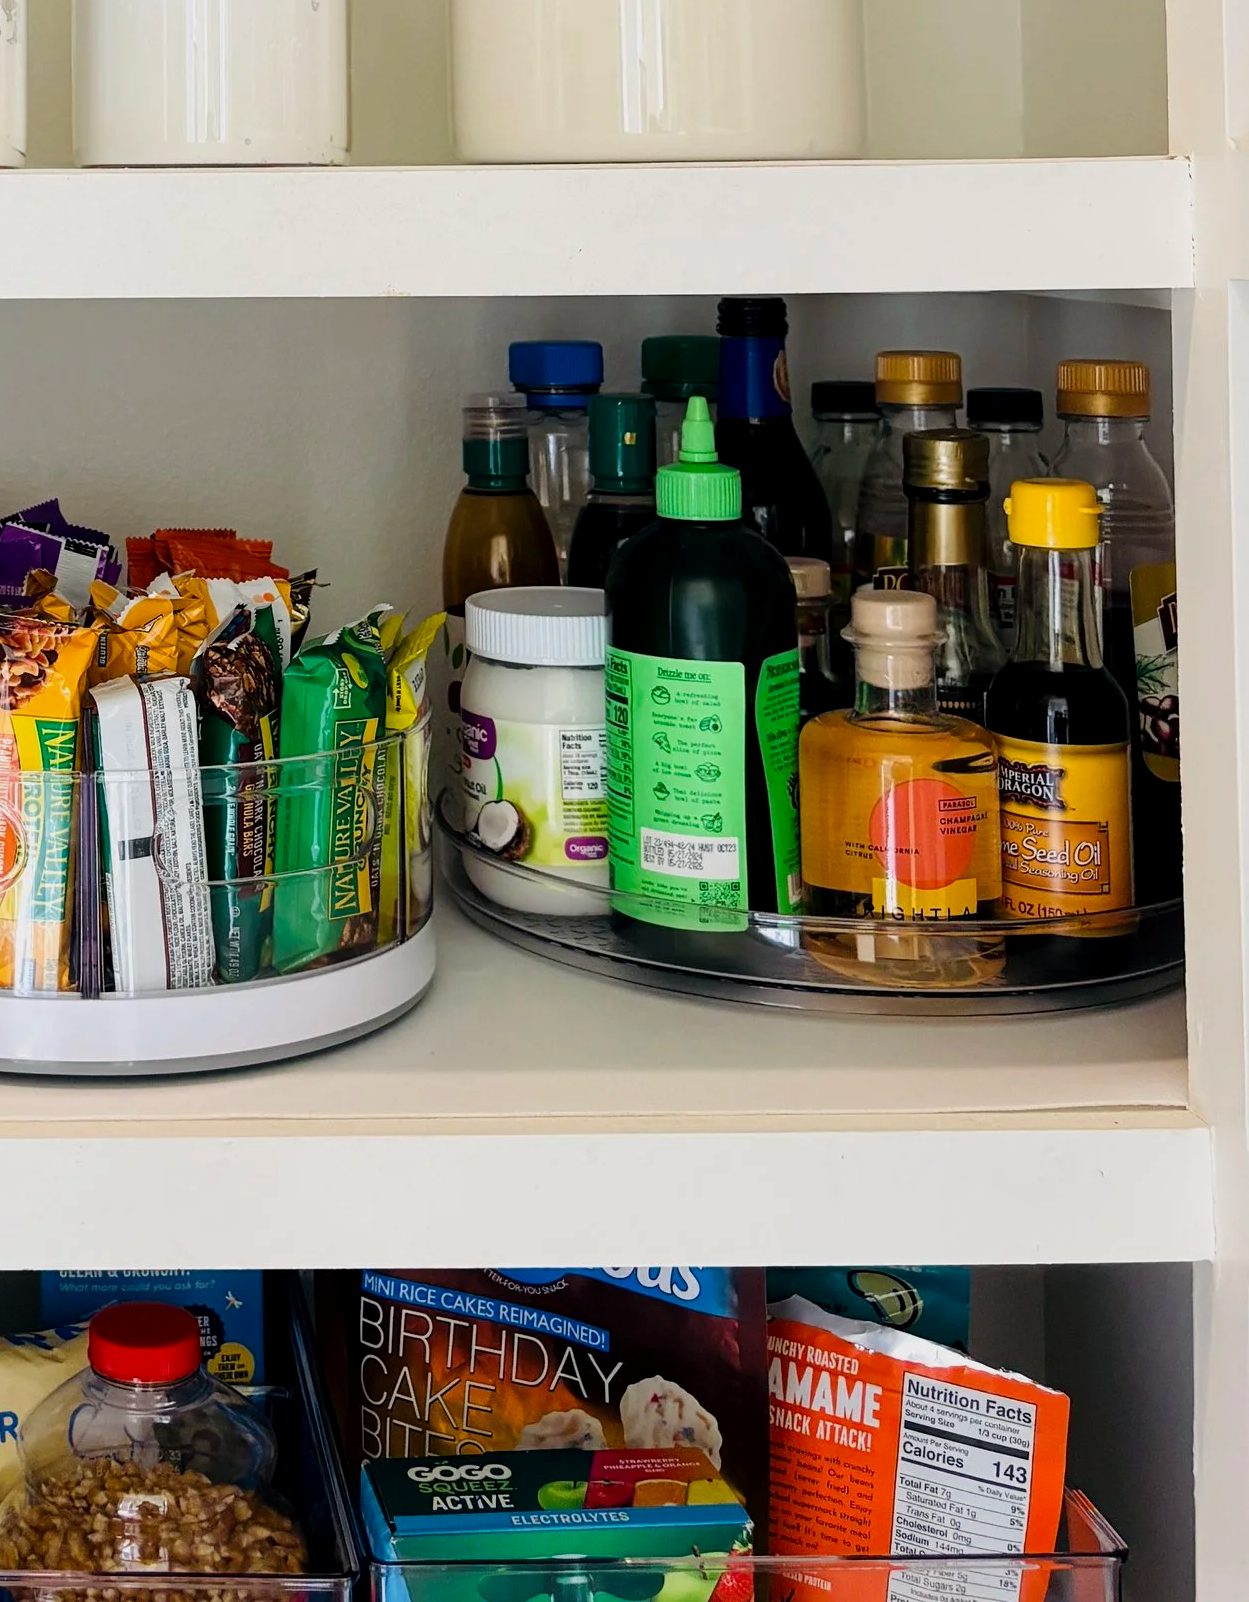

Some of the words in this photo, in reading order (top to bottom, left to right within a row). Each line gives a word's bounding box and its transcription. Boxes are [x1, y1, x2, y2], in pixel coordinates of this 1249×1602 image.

[610, 658, 628, 674] Facts
[658, 667, 683, 679] Drizzle
[614, 705, 628, 725] 120
[562, 734, 592, 742] Nutrition
[562, 742, 582, 750] Facts
[41, 726, 75, 821] NATURE
[475, 782, 487, 795] Oil
[943, 800, 974, 809] PARASOL
[940, 811, 988, 825] CHAMPAGNE
[940, 825, 978, 835] VINEGAR
[1025, 823, 1049, 837] Pure
[242, 830, 253, 857] BARS
[569, 843, 604, 855] Organic
[845, 841, 865, 849] WITH
[1021, 836, 1070, 866] Seed
[1074, 840, 1101, 866] Oil
[846, 849, 873, 860] CITRUS
[34, 824, 70, 916] VALLEY
[1020, 862, 1080, 884] Seasoning
[1081, 867, 1098, 881] Oil
[1005, 897, 1015, 911] FL
[1018, 903, 1034, 916] OZ
[60, 1282, 89, 1293] What
[121, 1282, 150, 1291] could
[153, 1283, 171, 1293] you
[174, 1281, 191, 1290] ask
[194, 1280, 216, 1290] for?
[364, 1274, 395, 1295] MINI
[399, 1283, 436, 1306] RICE
[441, 1292, 495, 1318] CAKES
[499, 1304, 606, 1348] REIMAGINED!
[221, 1354, 241, 1362] ENJOY
[361, 1296, 623, 1403] BIRTHDAY
[807, 1346, 859, 1375] ROASTED
[361, 1354, 496, 1436] CAKE
[907, 1379, 980, 1411] Nutrition
[986, 1399, 1032, 1424] Facts
[905, 1399, 928, 1411] About
[936, 1408, 968, 1422] servings
[984, 1419, 1020, 1435] container
[769, 1405, 811, 1436] SNACK
[816, 1419, 872, 1452] ATTACK!
[904, 1409, 935, 1424] Serving
[938, 1417, 955, 1428] Size
[1009, 1434, 1030, 1449] (30g)
[903, 1432, 928, 1445] Amount
[603, 1463, 652, 1471] PINEAPPLE
[662, 1461, 701, 1469] ORANGE
[788, 1445, 821, 1461] cravings
[824, 1454, 841, 1466] with
[844, 1461, 876, 1477] crunchy
[902, 1441, 965, 1469] Calories
[992, 1461, 1028, 1484] 143
[407, 1463, 512, 1482] GOGO
[828, 1469, 844, 1479] Our
[418, 1480, 515, 1494] SQUEEZ
[899, 1476, 922, 1489] Total
[924, 1484, 939, 1494] Fat
[432, 1494, 515, 1511] ACTIVE
[857, 1491, 874, 1502] and
[906, 1491, 947, 1510] Saturated
[949, 1503, 964, 1515] Fat
[850, 1500, 872, 1515] Enjoy
[906, 1505, 930, 1519] Trans
[931, 1513, 946, 1524] Fat
[511, 1512, 629, 1525] ELECTROLYTES
[816, 1515, 847, 1532] favorite
[840, 1511, 871, 1527] straight
[896, 1516, 948, 1538] Cholesterol
[843, 1537, 850, 1547] to
[895, 1529, 930, 1546] Sodium
[804, 1574, 832, 1591] PROTEIN
[923, 1576, 954, 1591] Sugars
